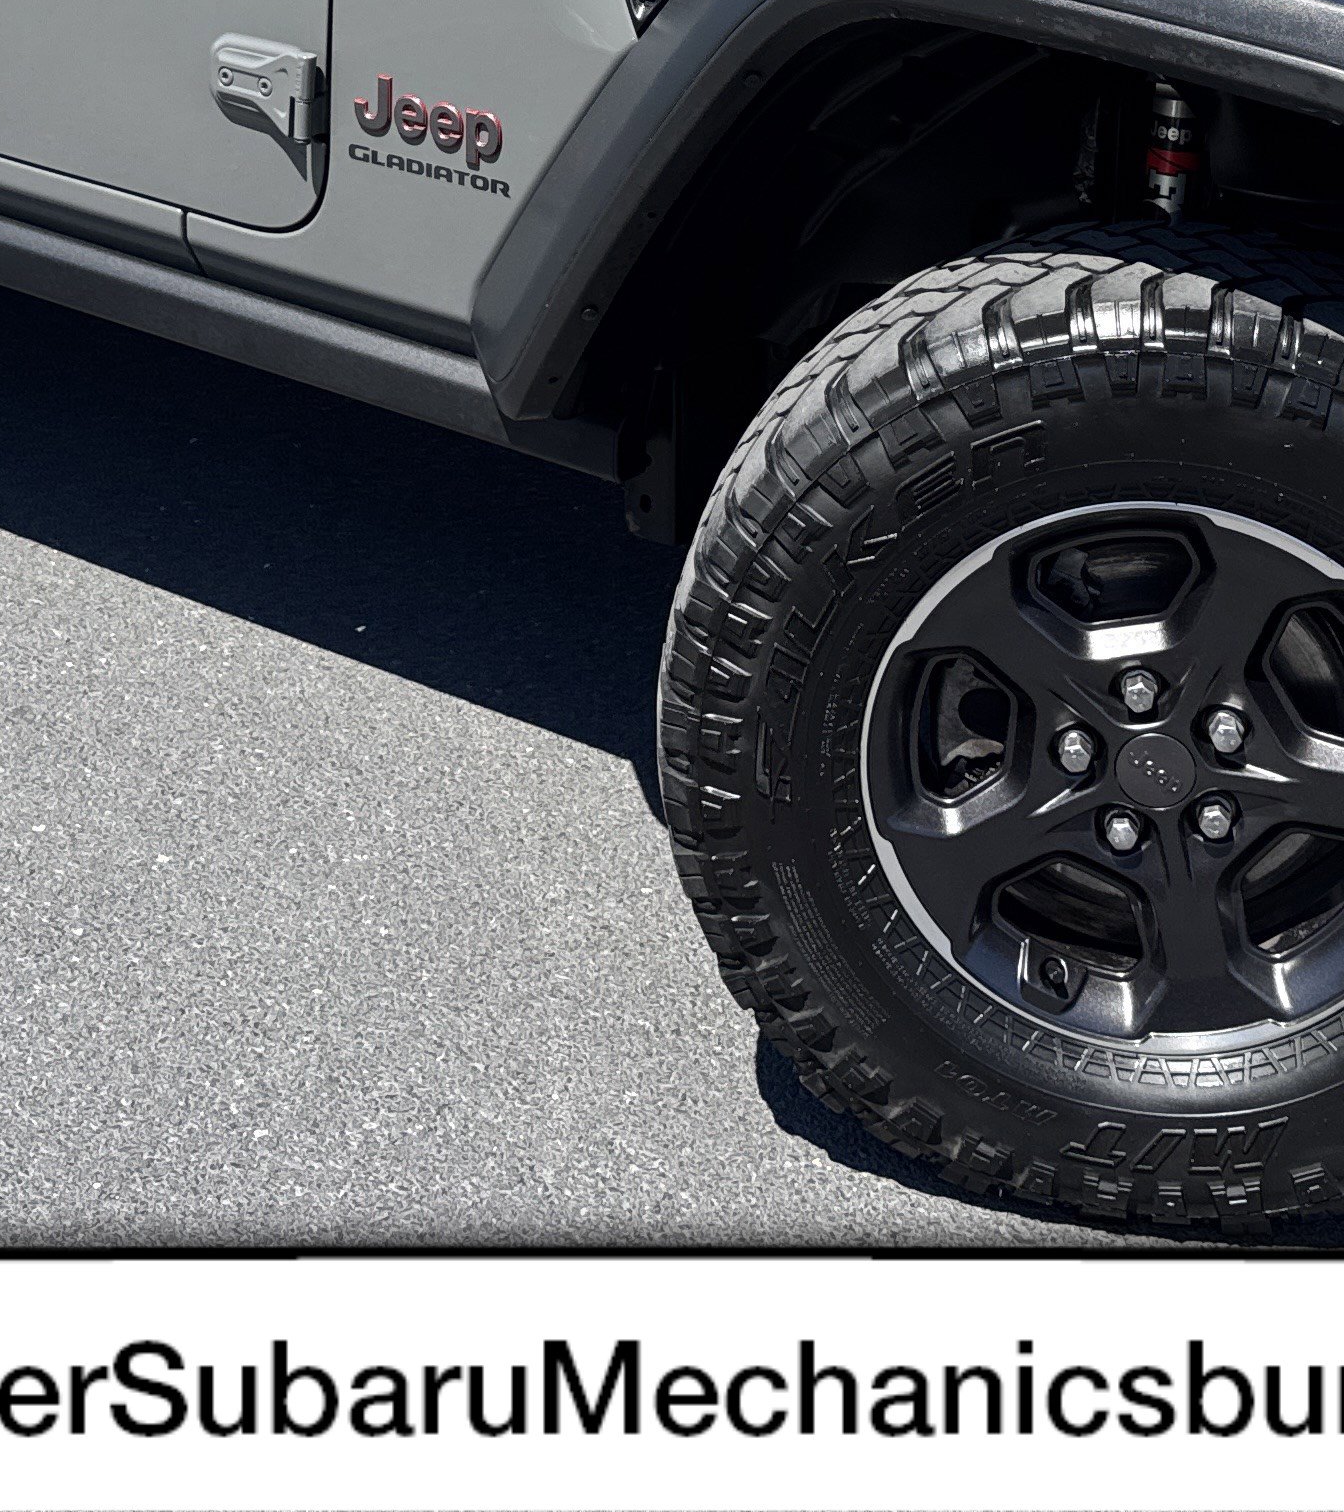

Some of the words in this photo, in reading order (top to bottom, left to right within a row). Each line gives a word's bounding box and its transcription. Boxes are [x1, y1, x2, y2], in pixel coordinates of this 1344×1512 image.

[353, 73, 503, 170] Jeep
[1150, 119, 1193, 146] Jeep
[348, 143, 511, 199] GLADIATOR
[1060, 1116, 1289, 1178] M/T
